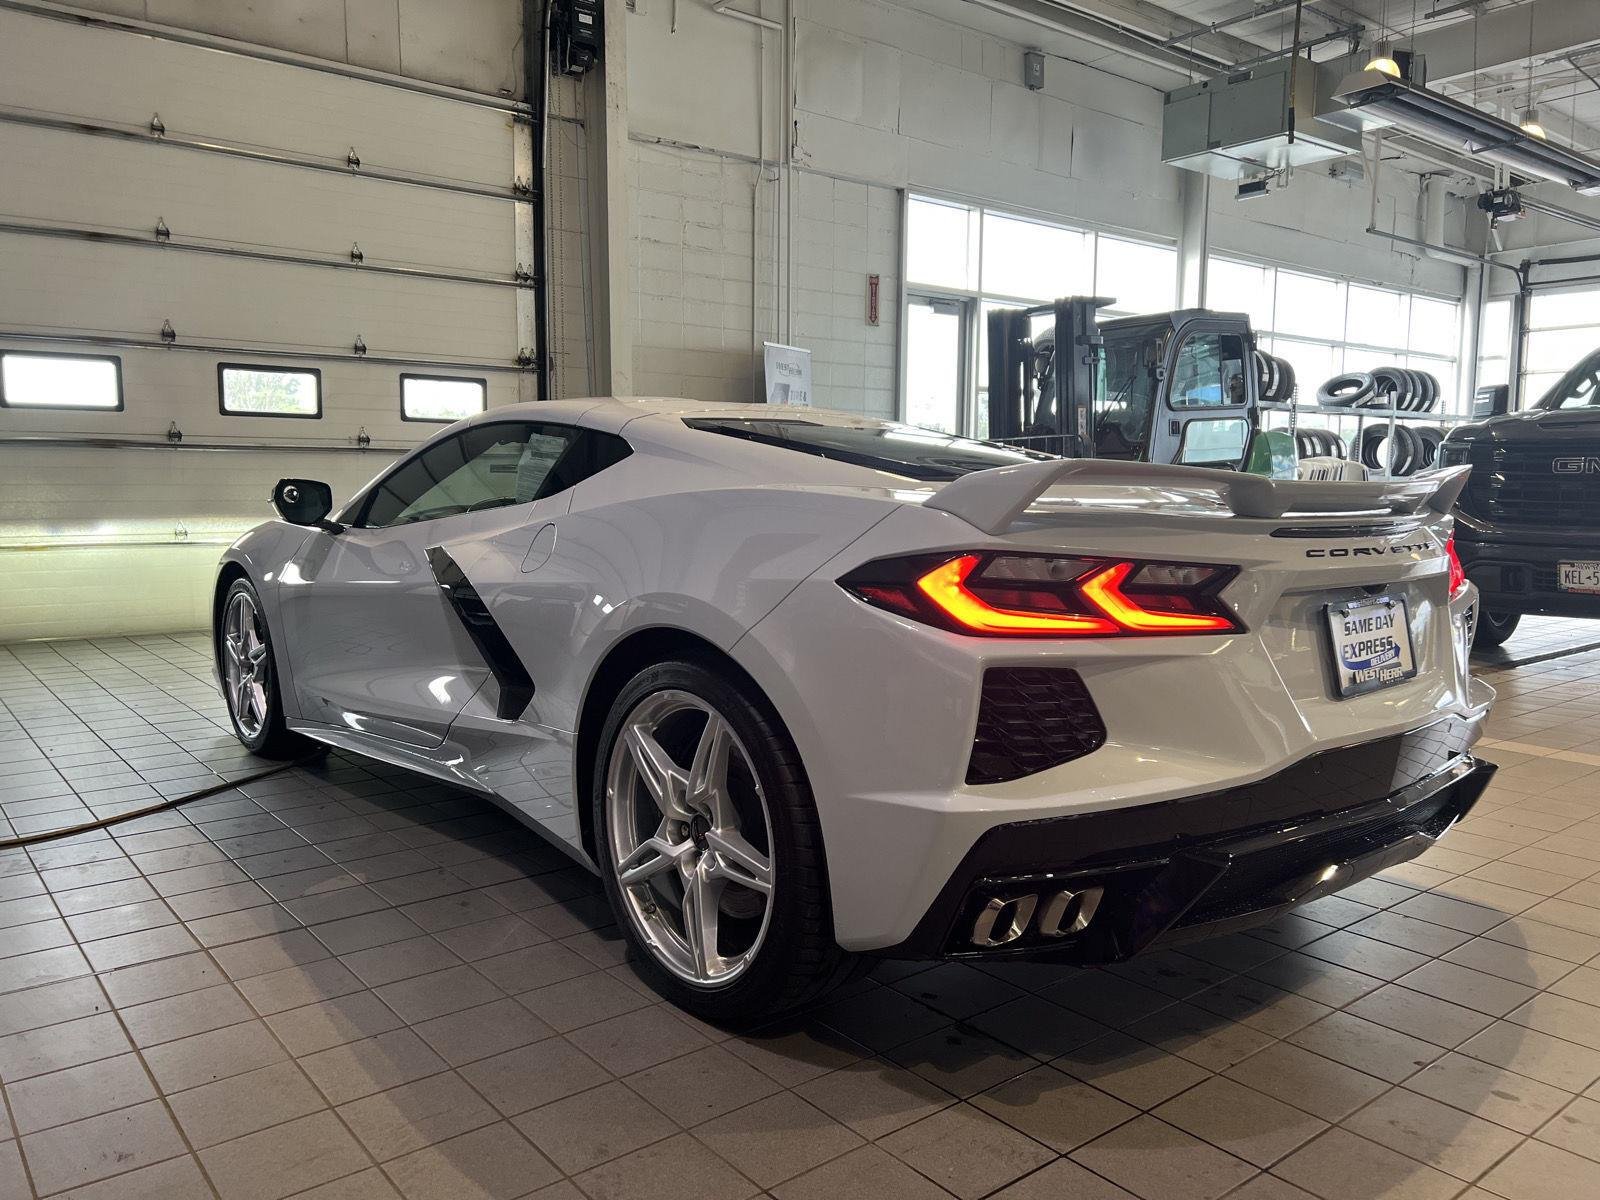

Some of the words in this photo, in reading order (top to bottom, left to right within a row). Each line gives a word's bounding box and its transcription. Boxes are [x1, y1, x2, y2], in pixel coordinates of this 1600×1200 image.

[1344, 617, 1374, 637] SAME
[1375, 613, 1396, 631] DAY
[1343, 636, 1394, 660] EXPRESS
[1370, 650, 1396, 667] DELIVERY
[1354, 667, 1380, 684] WEST
[1379, 668, 1403, 682] HERR
